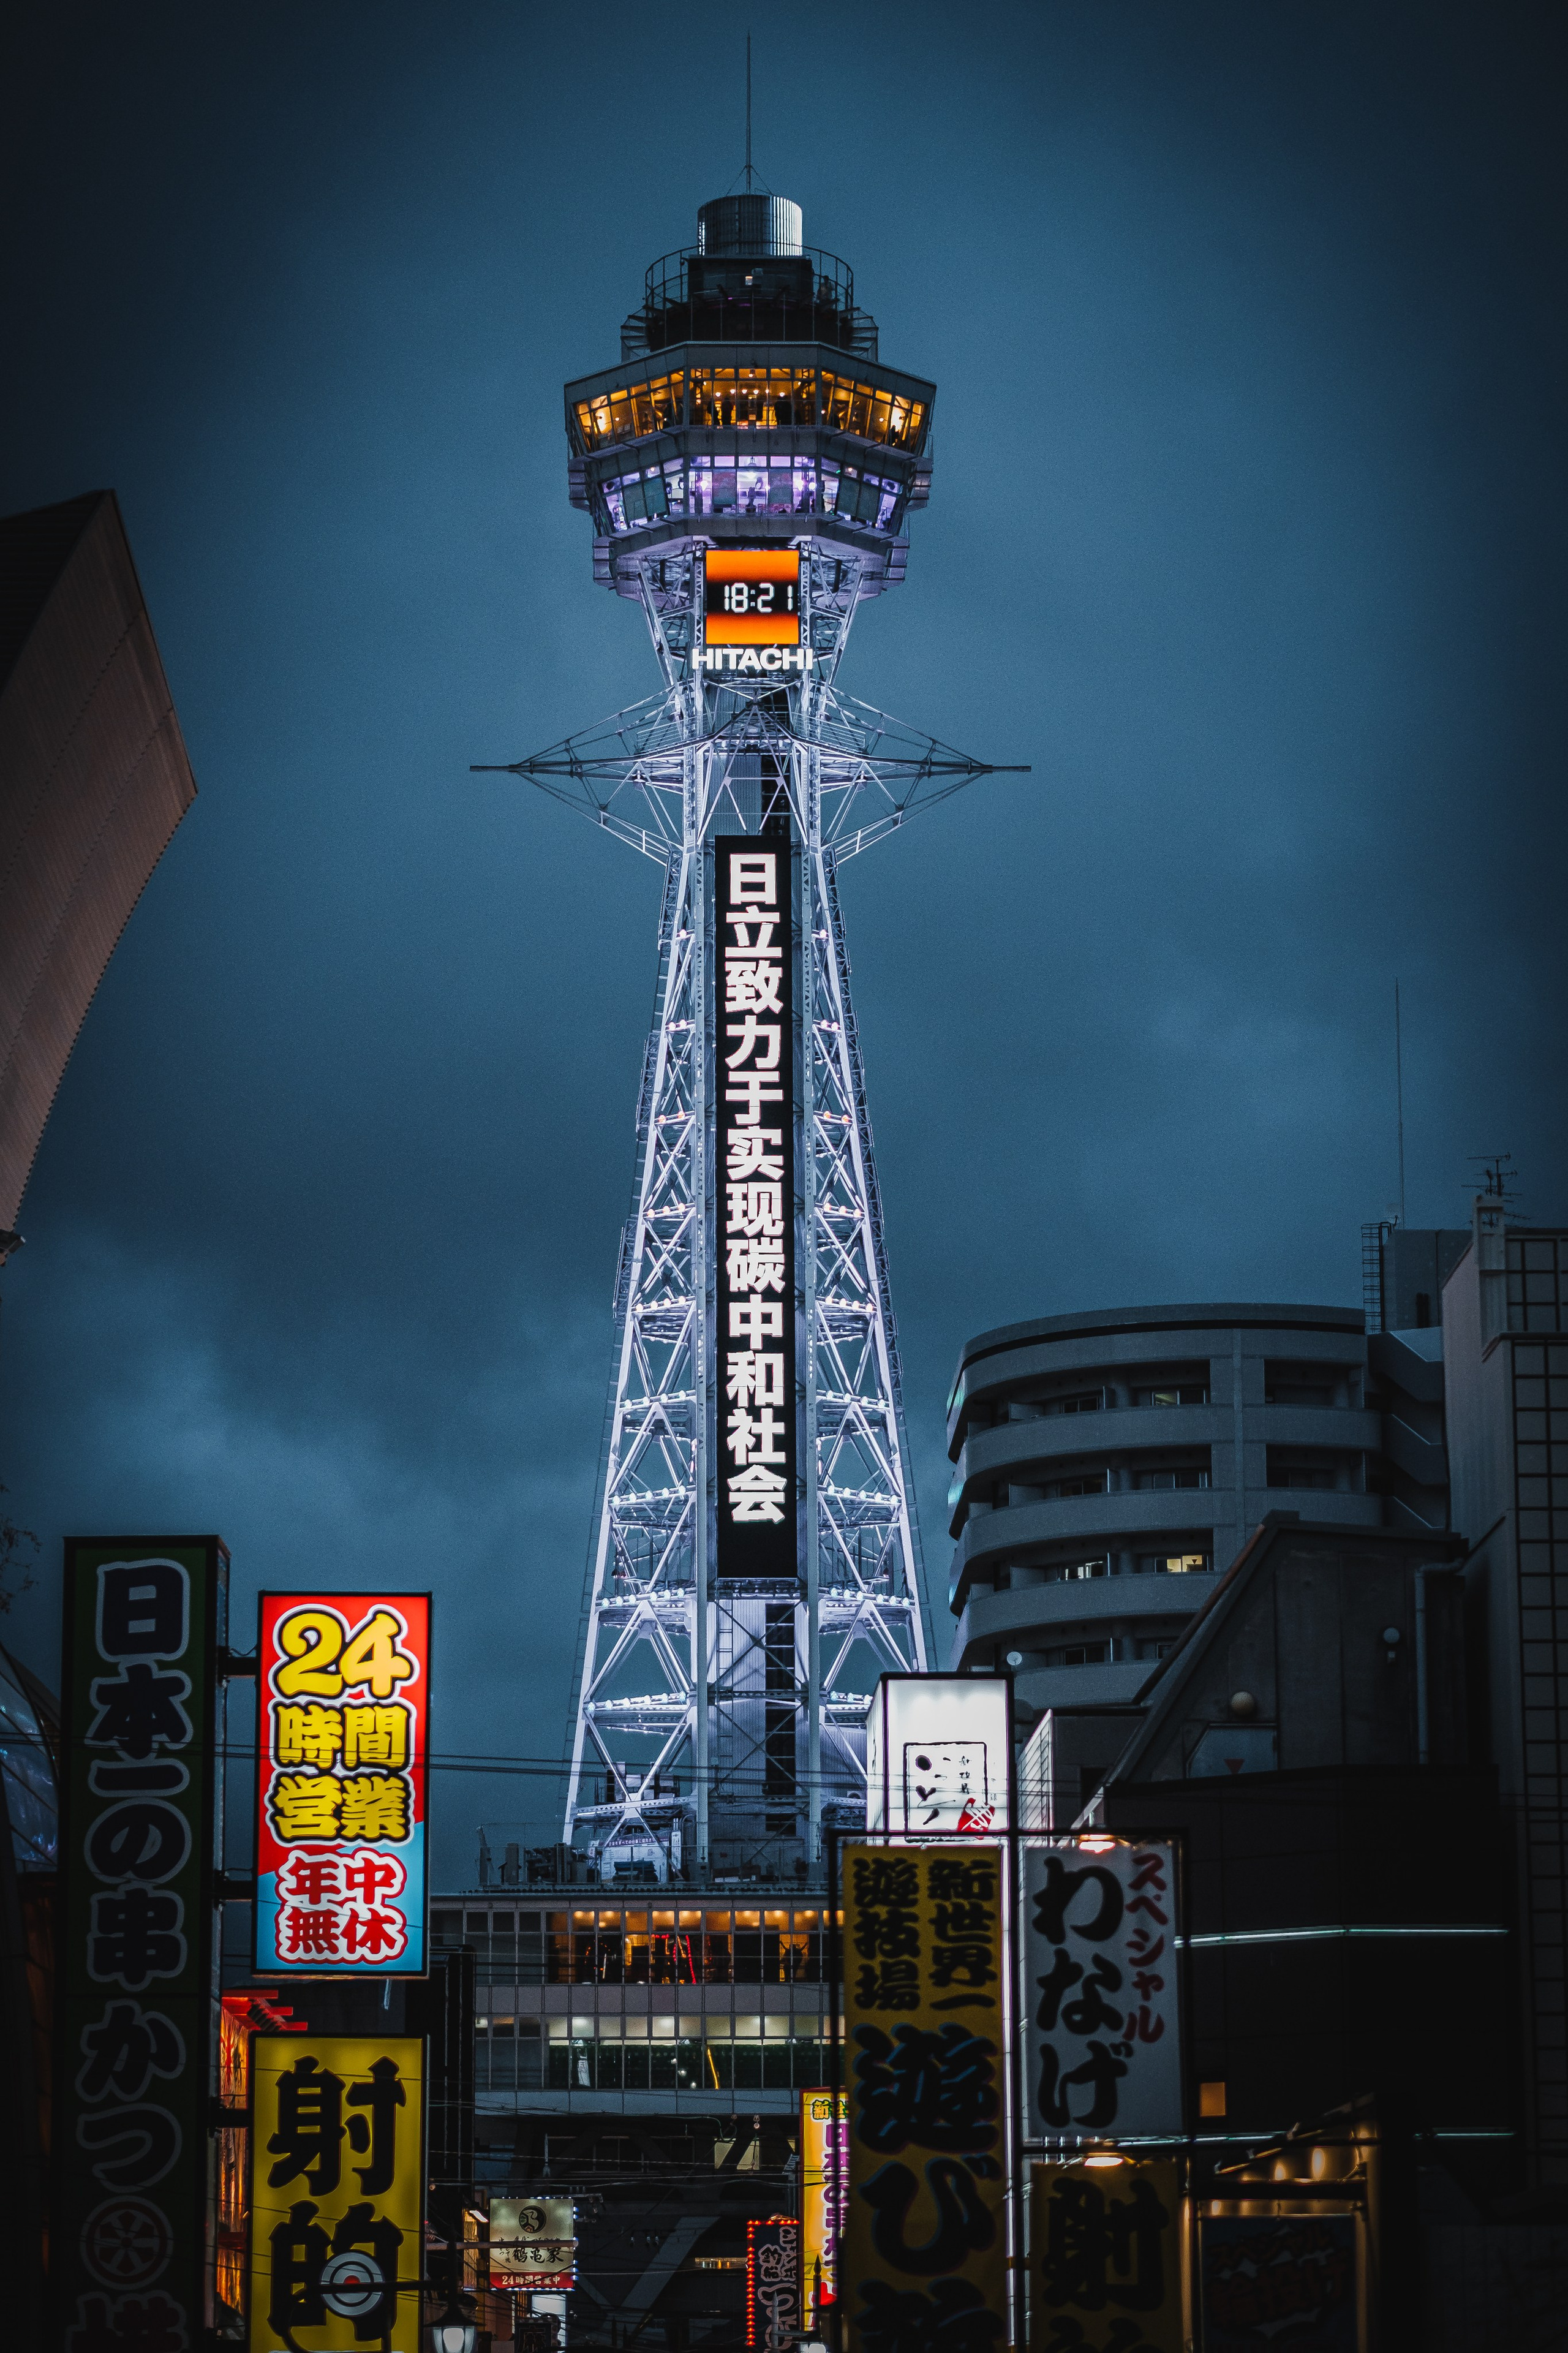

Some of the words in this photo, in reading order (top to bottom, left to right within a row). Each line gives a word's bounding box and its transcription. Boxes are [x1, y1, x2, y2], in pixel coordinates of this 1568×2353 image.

[723, 582, 793, 613] 18:21
[692, 648, 813, 670] HITACHI
[725, 853, 786, 1523] 日立致力于实现碳中和社会
[276, 1607, 418, 1699] 24
[273, 1702, 412, 1770] 時間
[271, 1773, 409, 1841] 営業
[76, 1558, 192, 2193] 日本一の串かつ
[284, 1855, 398, 1905] 年中
[284, 1906, 398, 1955] 無休
[853, 1857, 920, 2010] 遊技場
[929, 1859, 997, 2010] 新世界一
[1123, 1853, 1169, 2044] スペシャル
[1033, 1856, 1133, 2129] わなげ
